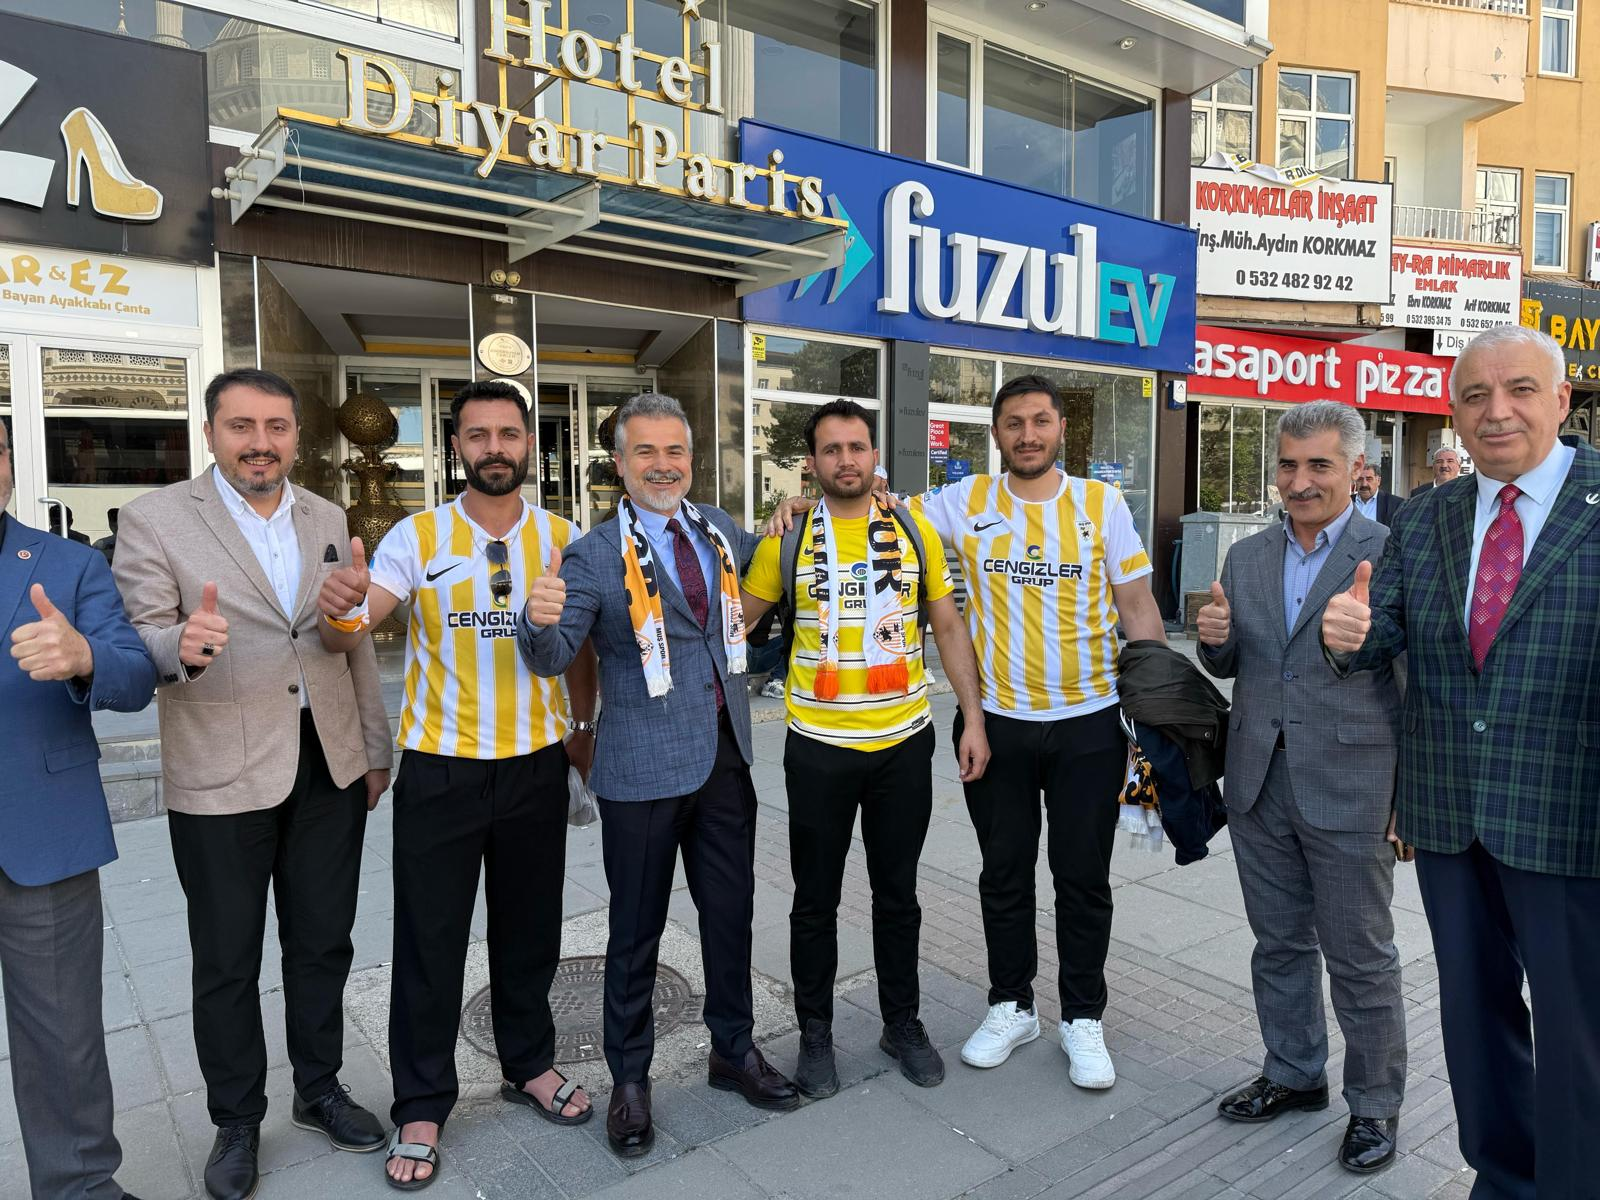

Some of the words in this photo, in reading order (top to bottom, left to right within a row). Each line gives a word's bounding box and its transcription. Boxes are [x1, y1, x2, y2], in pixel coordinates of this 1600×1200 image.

[483, 0, 725, 114] Hotel
[336, 48, 608, 179] Diyar
[633, 119, 824, 219] Paris
[1196, 180, 1314, 222] KORKMAZLAR
[1317, 186, 1378, 229] İNŞAAT
[1302, 236, 1376, 258] KORKMAZ
[1437, 253, 1511, 280] MİMARLIK
[1236, 269, 1246, 285] 0
[1250, 270, 1278, 287] 532
[1281, 273, 1310, 289] 482
[1313, 275, 1332, 291] 92
[1335, 276, 1353, 291] 42
[1415, 278, 1458, 293] EMLAK
[2, 288, 46, 306] Bayan
[49, 294, 112, 312] Ayakkabı
[114, 301, 151, 314] Çanta
[1407, 294, 1421, 308] Ebru
[1421, 296, 1452, 310] KORKMAZ
[1477, 300, 1511, 314] KORKMAZ
[1385, 313, 1394, 323] 99
[1411, 315, 1423, 324] 532
[1424, 315, 1436, 325] 395
[1436, 316, 1444, 325] 34
[1444, 317, 1452, 326] 75
[1466, 319, 1480, 328] 532
[1356, 351, 1443, 405] pizza
[983, 559, 1083, 580] CENGIZLER
[1011, 576, 1054, 587] GRUP
[844, 600, 867, 610] GR
